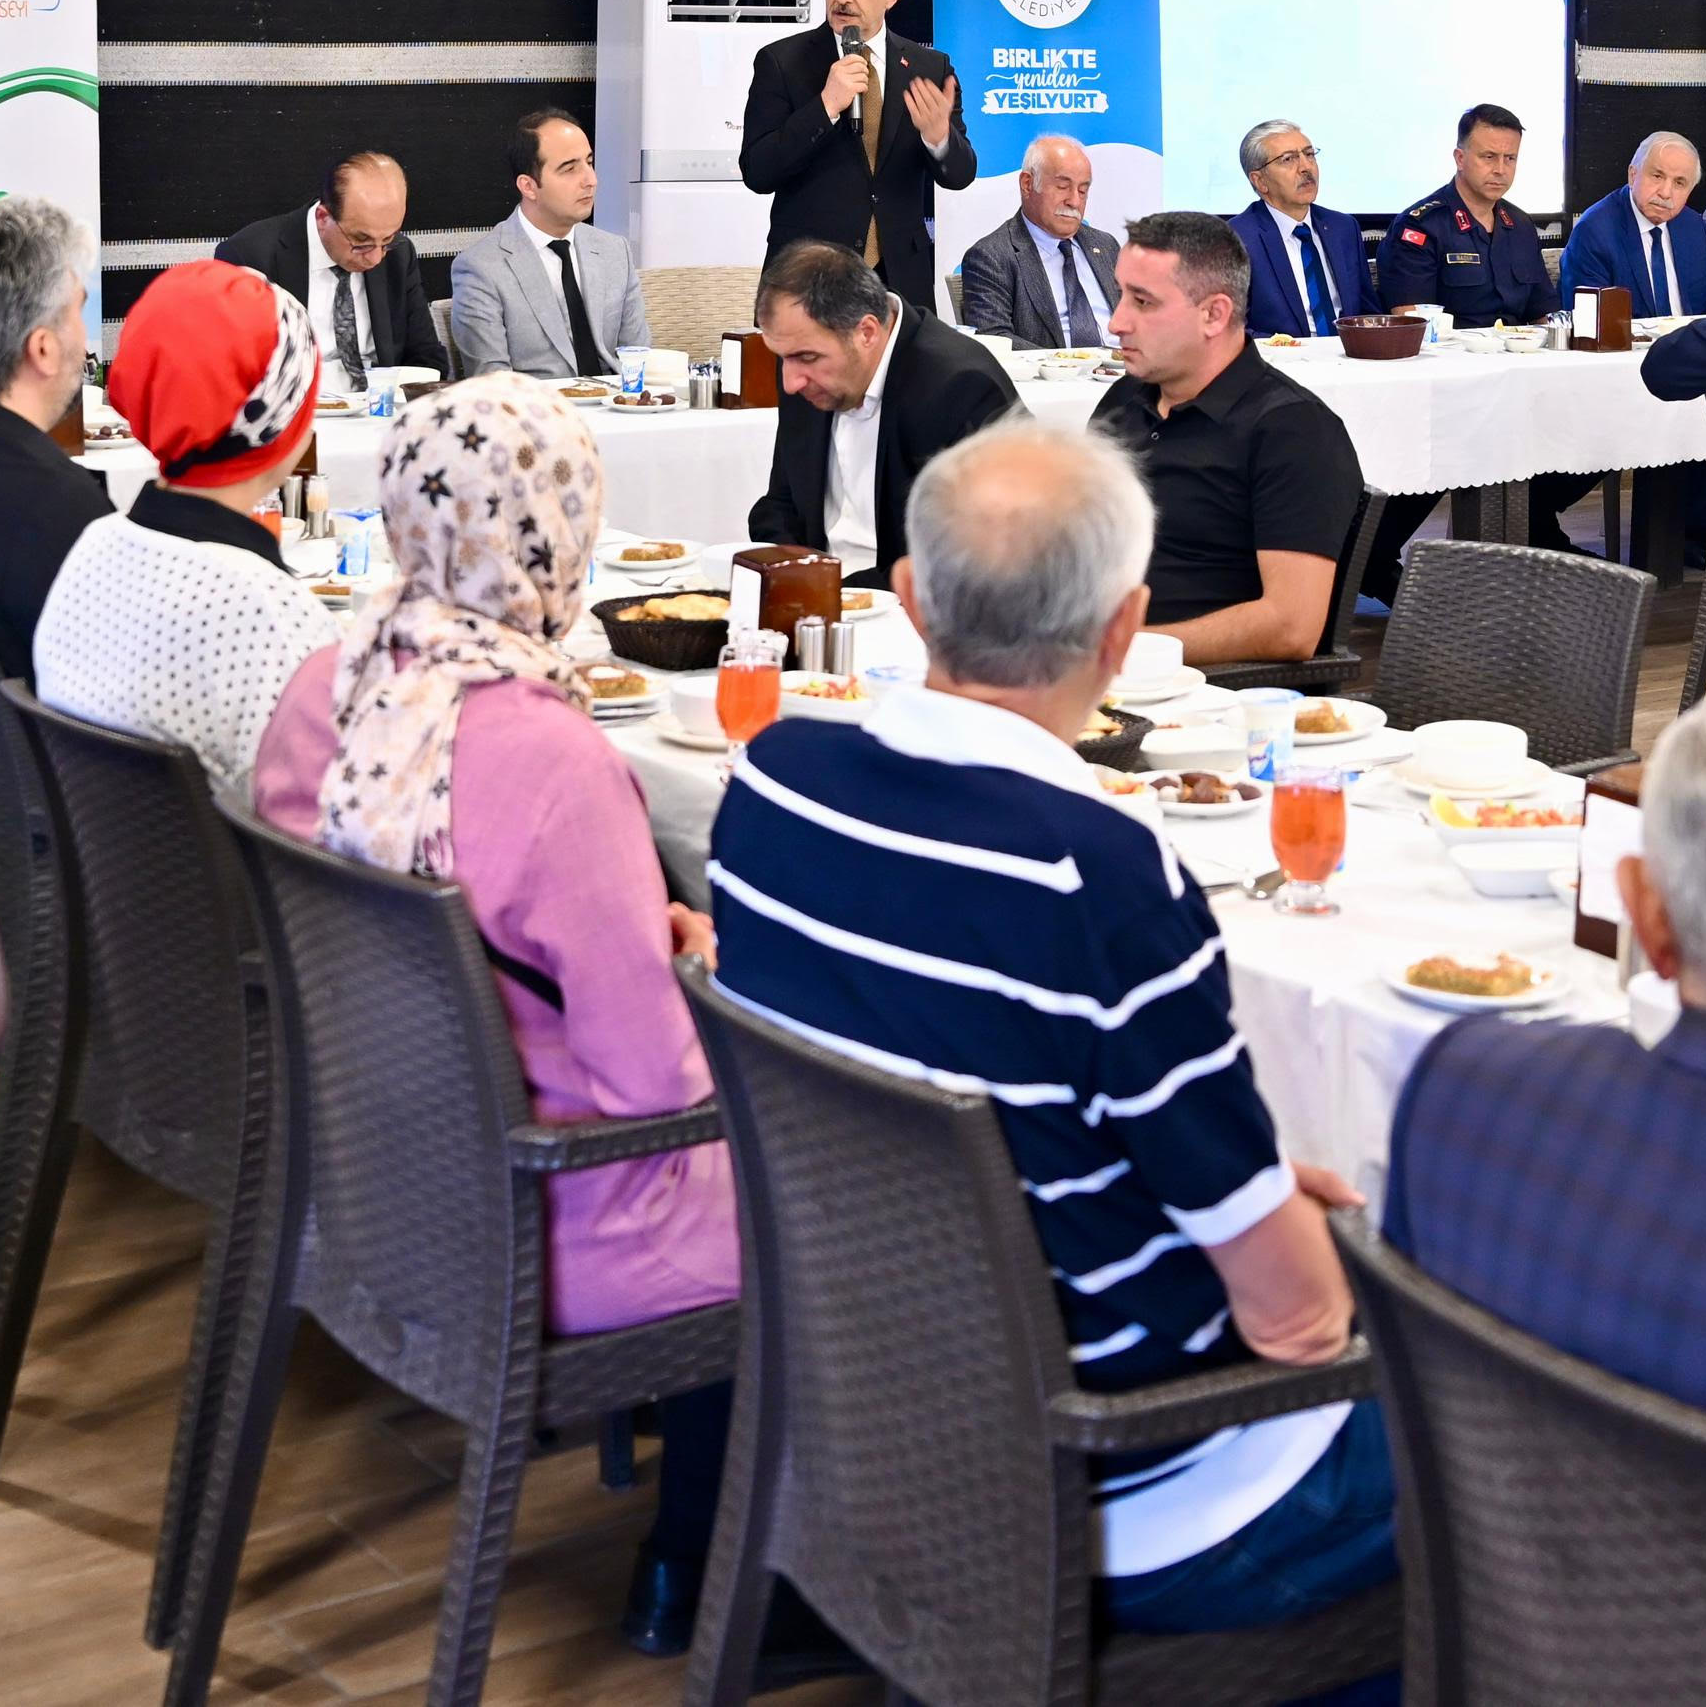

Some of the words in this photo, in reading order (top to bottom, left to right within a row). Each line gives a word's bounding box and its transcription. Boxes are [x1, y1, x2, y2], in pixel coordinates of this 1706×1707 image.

[993, 48, 1097, 69] BİRLİKTE
[1014, 61, 1078, 92] yeniden
[994, 92, 1098, 110] YEŞİLYURT
